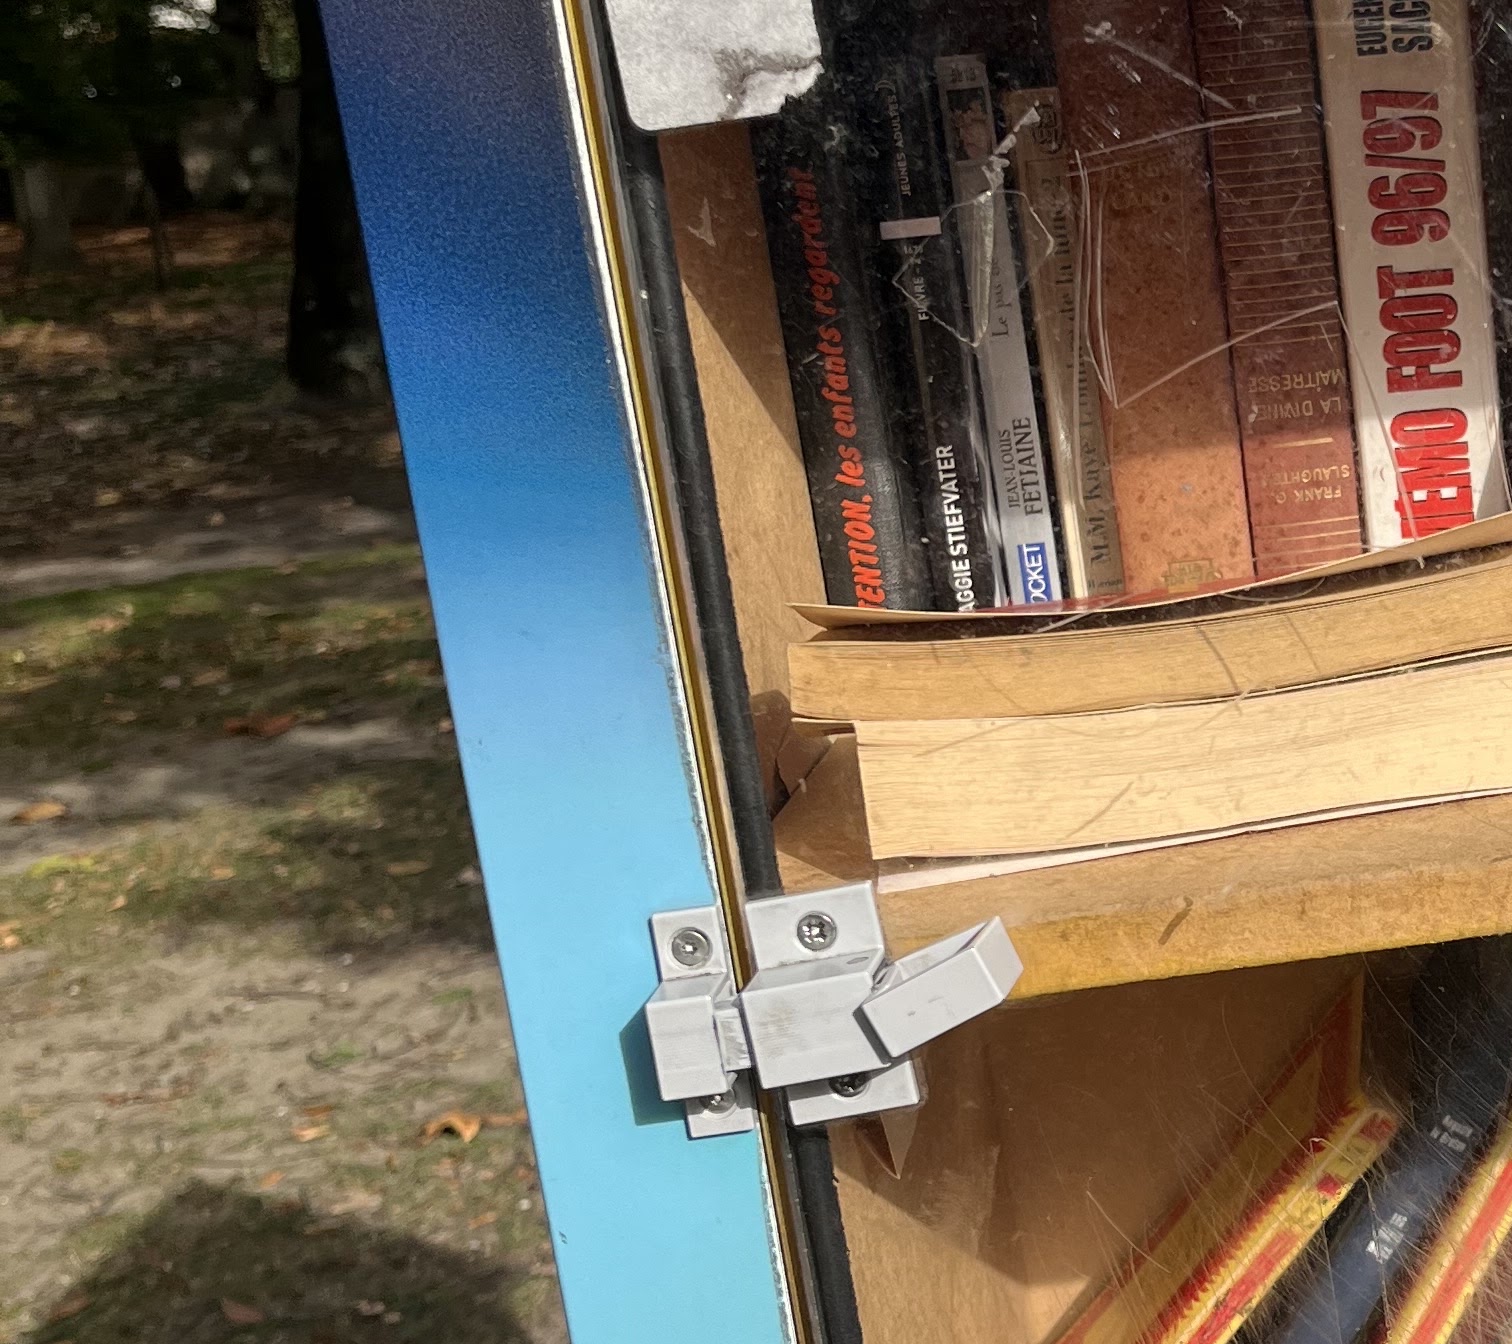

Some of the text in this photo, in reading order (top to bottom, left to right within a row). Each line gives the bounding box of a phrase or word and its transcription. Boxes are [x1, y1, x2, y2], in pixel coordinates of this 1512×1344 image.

[1360, 89, 1451, 247] 96/97
[790, 166, 840, 316] regardent
[992, 316, 1009, 337] Le
[1377, 265, 1463, 394] FOOT
[818, 325, 857, 439] enfants
[1248, 367, 1347, 393] MAÎTRESSE
[1320, 396, 1342, 414] LA
[835, 445, 867, 488] les
[936, 444, 969, 555] STIEFVATER
[999, 430, 1020, 509] JEAN-LOUIS
[1012, 417, 1044, 517] FETJAINE
[1260, 464, 1351, 488] SLAUGHTE
[1294, 485, 1342, 502] FRANK
